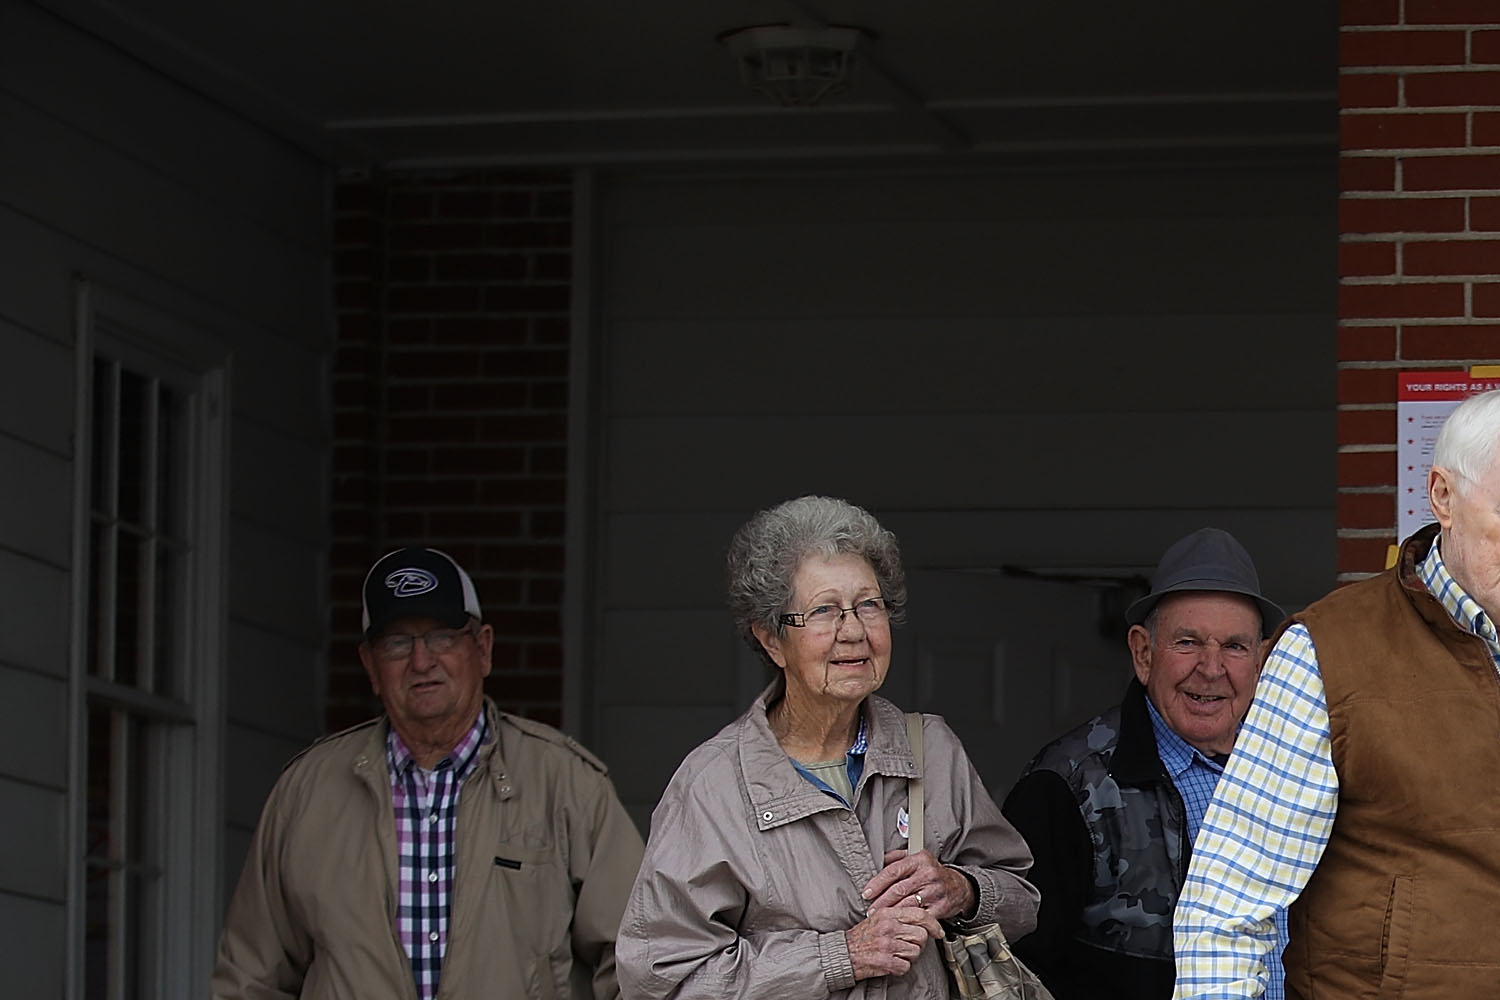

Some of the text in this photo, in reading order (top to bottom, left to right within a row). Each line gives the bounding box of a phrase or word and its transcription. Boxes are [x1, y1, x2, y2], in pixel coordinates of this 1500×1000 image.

[1406, 383, 1433, 392] YOUR
[1434, 383, 1468, 392] RIGHTS
[1469, 383, 1483, 392] AS
[1485, 383, 1494, 391] A
